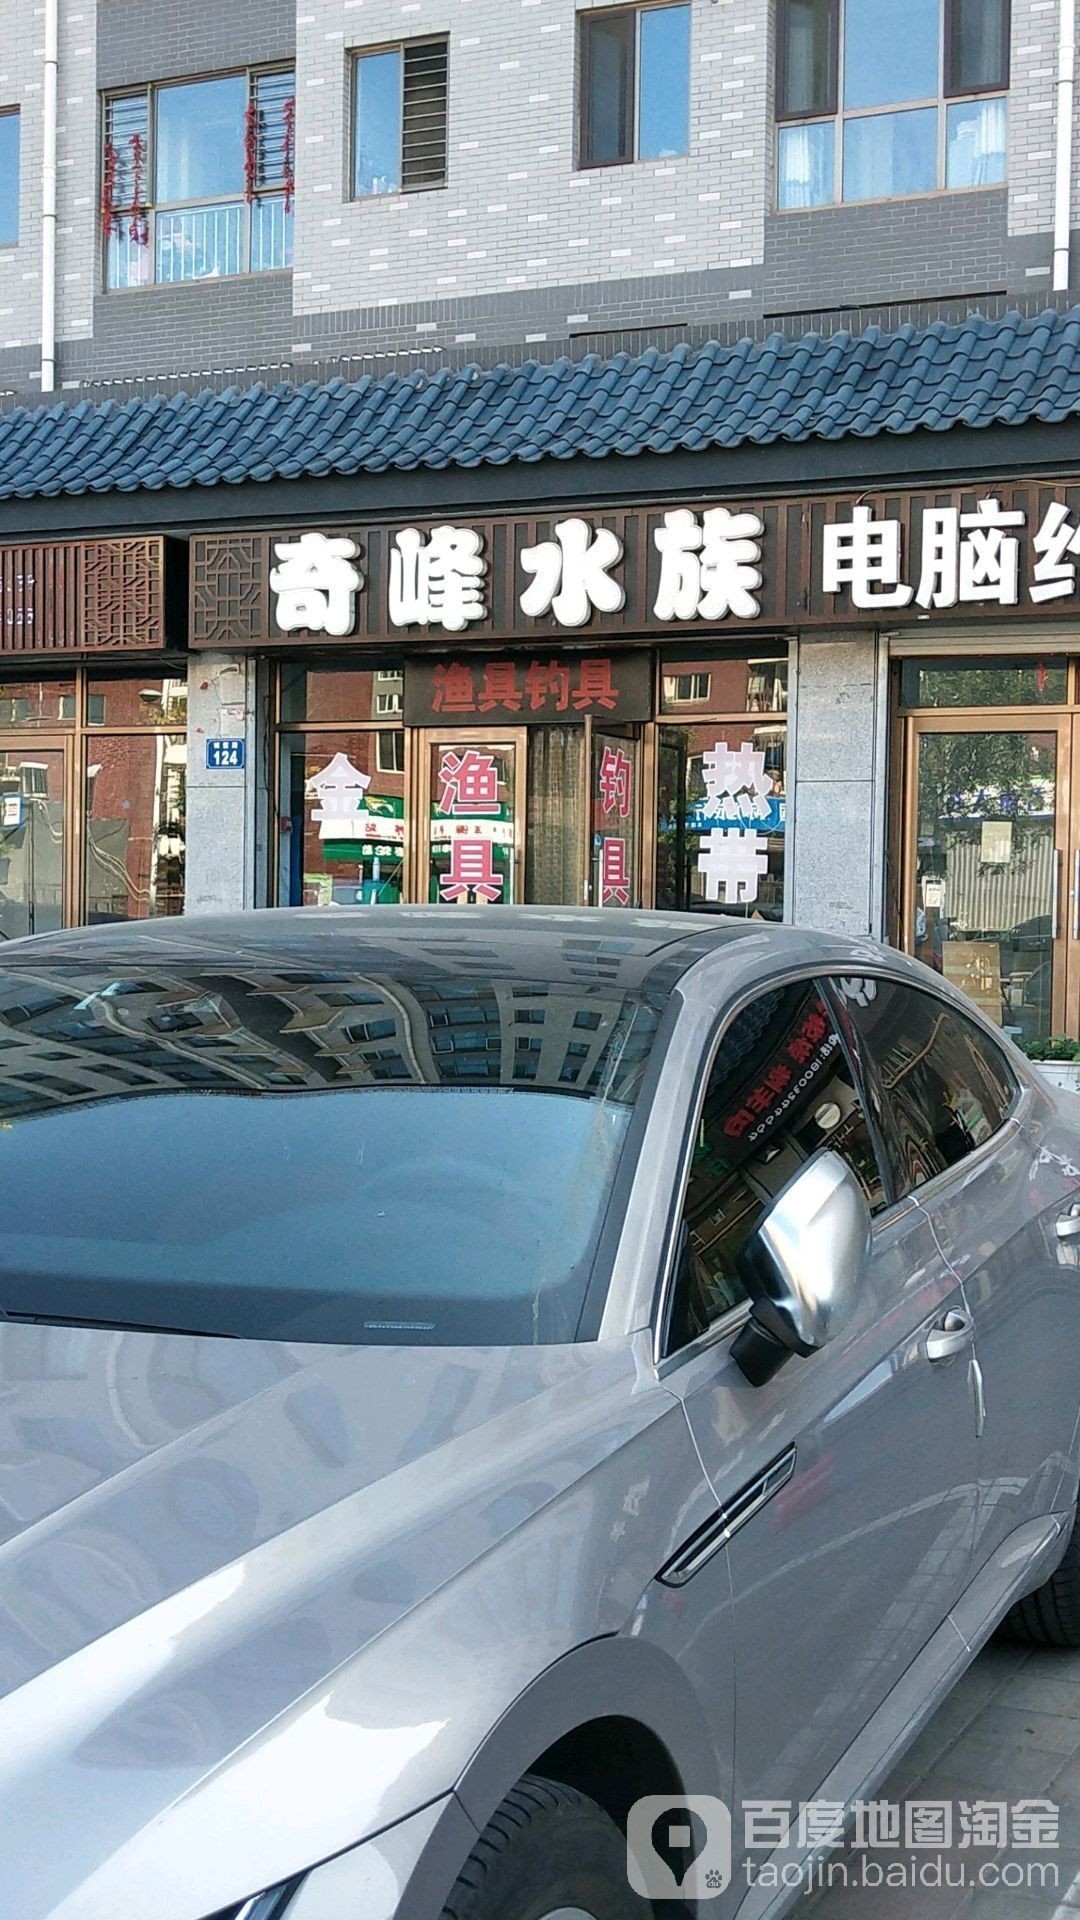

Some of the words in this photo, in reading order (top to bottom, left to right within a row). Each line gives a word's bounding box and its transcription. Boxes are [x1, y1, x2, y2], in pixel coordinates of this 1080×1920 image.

[269, 507, 763, 636] 奇峰水族
[431, 659, 619, 712] 渔具钓具
[213, 750, 238, 765] 124
[309, 752, 371, 821] 金
[438, 750, 503, 901] 渔具
[600, 746, 631, 904] 钓具
[698, 742, 773, 904] 热带
